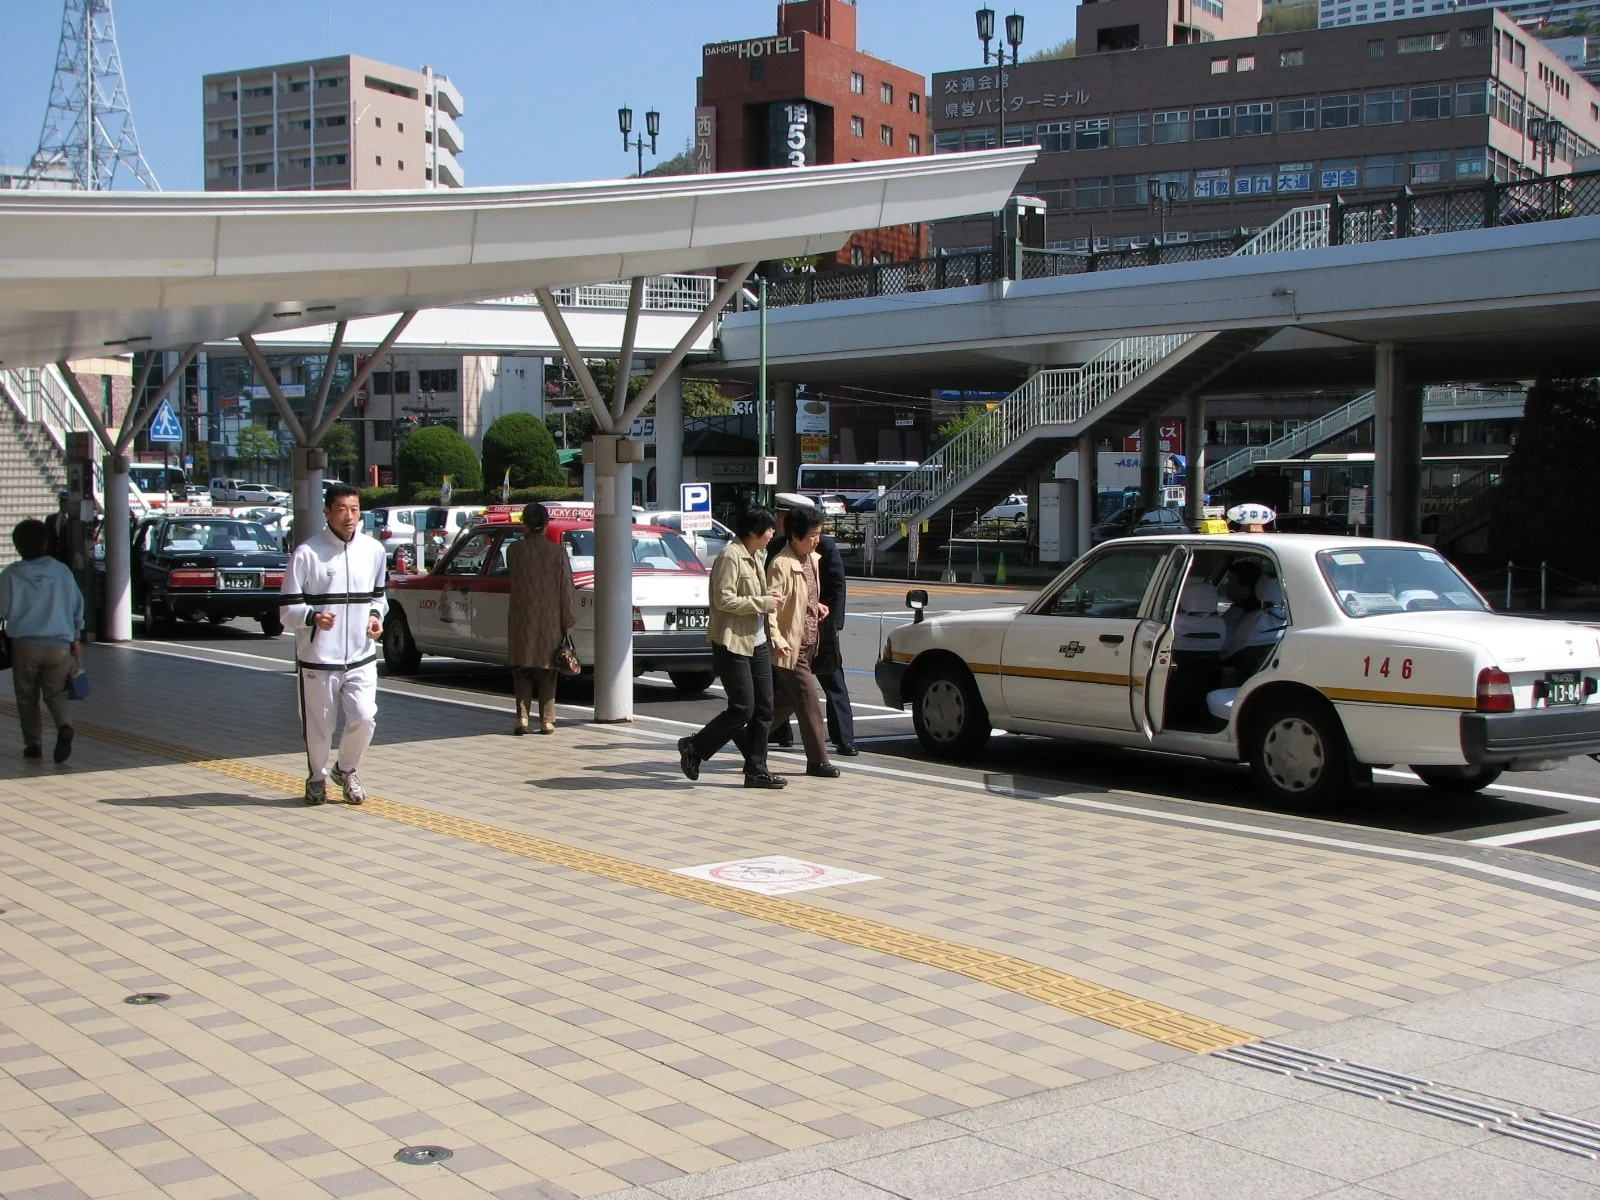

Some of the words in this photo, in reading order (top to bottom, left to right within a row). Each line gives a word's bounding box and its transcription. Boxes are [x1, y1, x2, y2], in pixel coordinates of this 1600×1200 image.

[705, 45, 737, 56] DAI-ICHI
[738, 36, 800, 59] HOTEL
[944, 73, 1009, 95] 交通会館
[784, 105, 808, 123] 1泊
[944, 89, 1090, 119] 県営バスターミナル
[684, 486, 708, 511] P
[419, 599, 438, 609] LUCKY
[455, 601, 469, 612] TAXI
[1363, 656, 1413, 680] 146
[1554, 684, 1580, 702] 13-84
